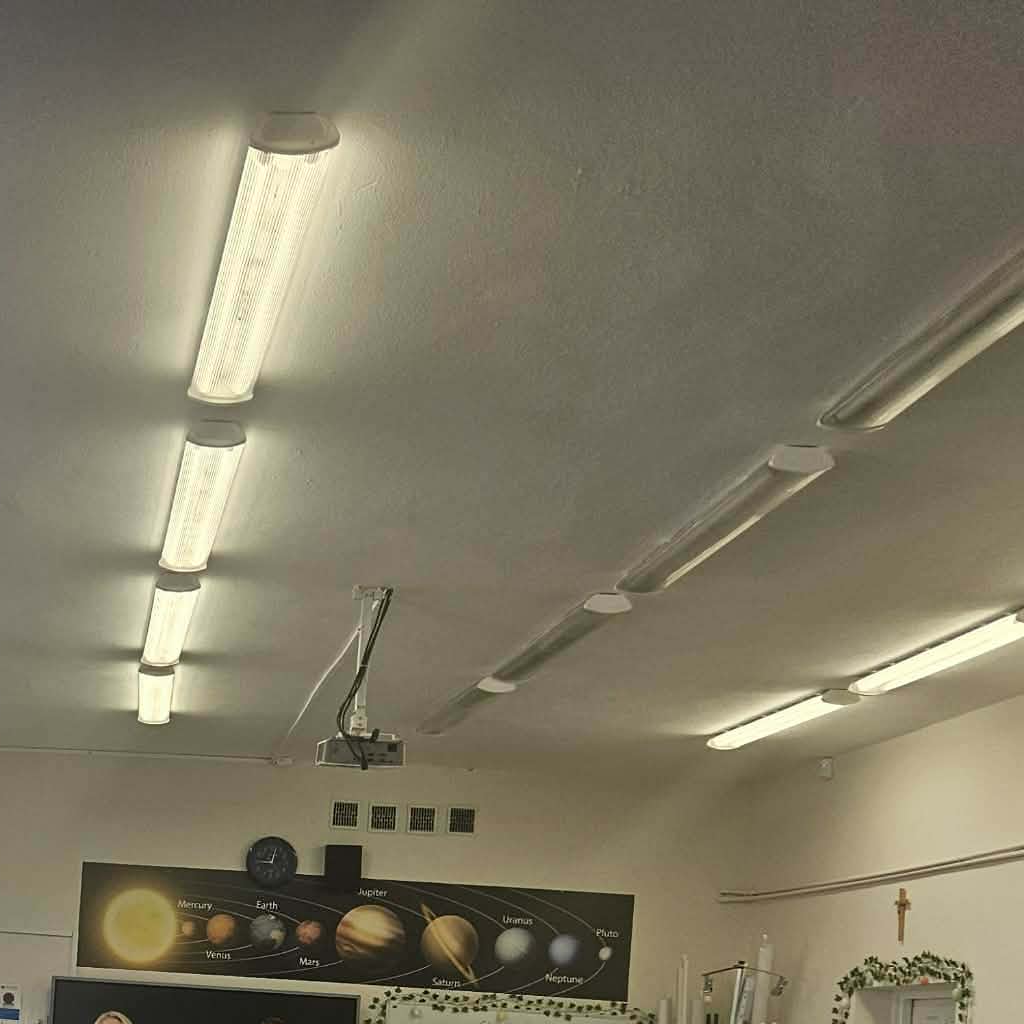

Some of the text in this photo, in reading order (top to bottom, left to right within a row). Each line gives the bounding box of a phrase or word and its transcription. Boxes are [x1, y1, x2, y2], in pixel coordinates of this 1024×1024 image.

[357, 888, 388, 898] Jupiter
[177, 900, 214, 911] Mercury
[256, 900, 278, 910] Earth
[502, 914, 534, 926] Uranus
[596, 928, 619, 938] Pluto
[206, 950, 232, 960] Venus
[299, 957, 320, 967] Mars
[544, 973, 584, 985] Neptune
